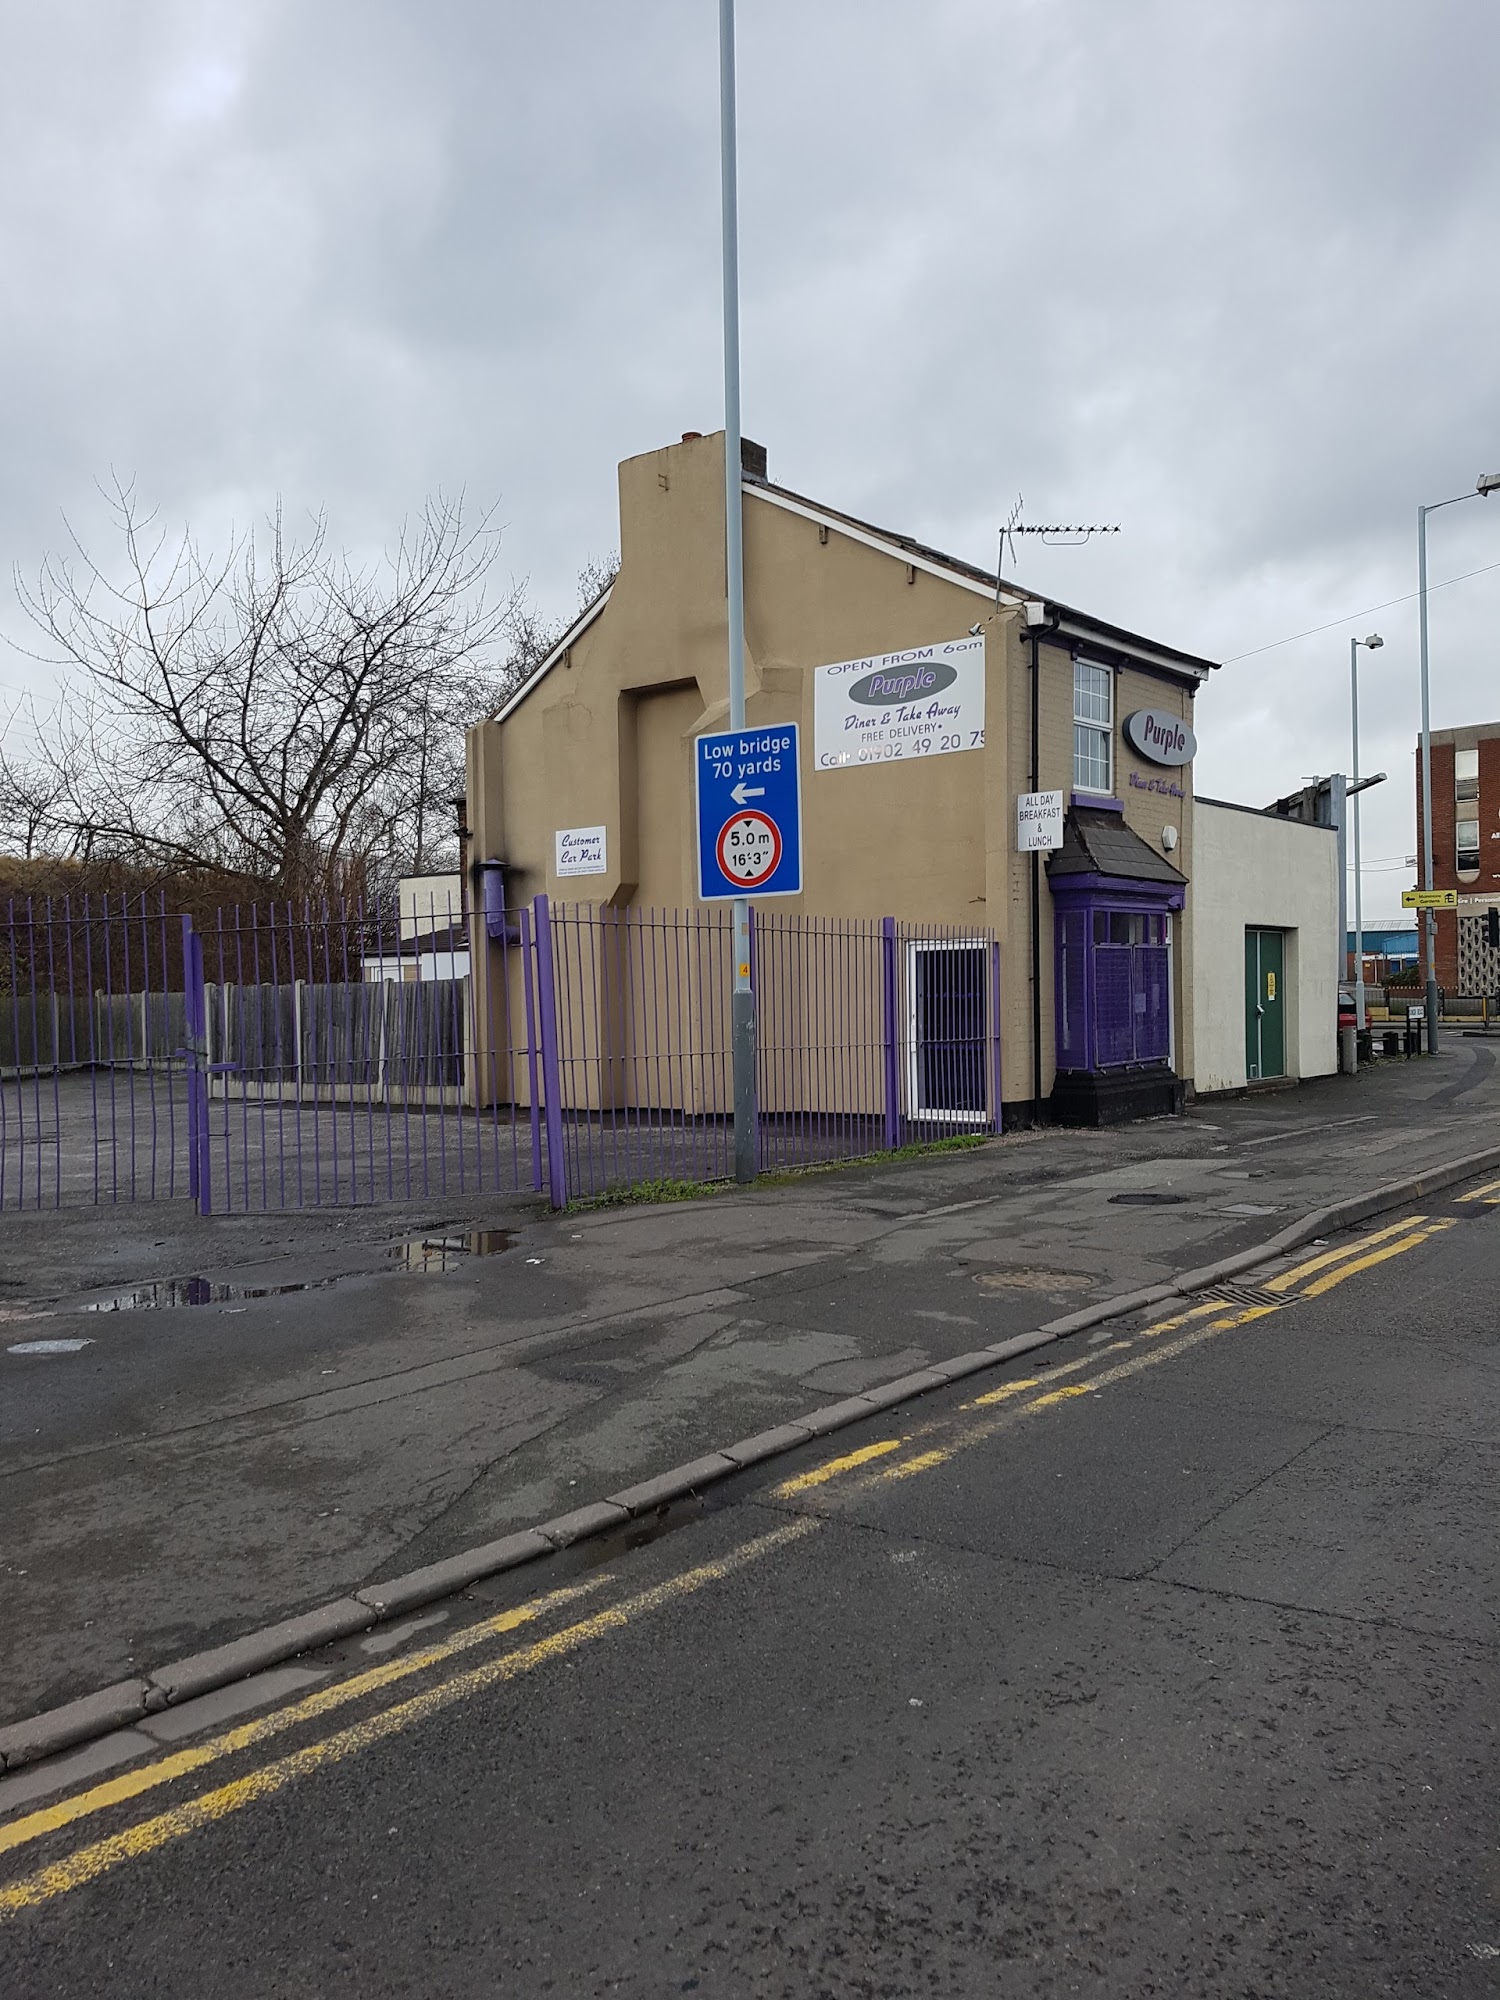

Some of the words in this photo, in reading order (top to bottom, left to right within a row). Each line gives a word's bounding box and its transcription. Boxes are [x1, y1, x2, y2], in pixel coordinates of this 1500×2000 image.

[827, 660, 874, 676] OPEN
[882, 648, 934, 666] FROM
[943, 641, 983, 654] 6am
[868, 666, 936, 698] Purple
[844, 714, 876, 731] Diner
[880, 712, 892, 725] &
[896, 706, 922, 722] Take
[926, 702, 961, 719] Away
[861, 729, 884, 743] FREE
[1144, 714, 1186, 755] Purple
[704, 744, 734, 760] Low
[740, 736, 791, 755] bridge
[858, 742, 903, 761] 01902
[912, 739, 932, 753] 49
[940, 734, 961, 750] 20
[712, 761, 732, 778] 70
[738, 756, 781, 779] yards
[1026, 796, 1038, 807] ALL
[1040, 794, 1055, 805] DAY
[1019, 807, 1061, 821] BREAKFAST
[1037, 822, 1042, 832] &
[562, 834, 600, 846] Customer
[731, 831, 754, 846] 5.0
[758, 833, 769, 844] m
[1028, 835, 1052, 847] LUNCH
[561, 851, 577, 863] Car
[579, 848, 602, 862] Park
[742, 966, 748, 974] 4
